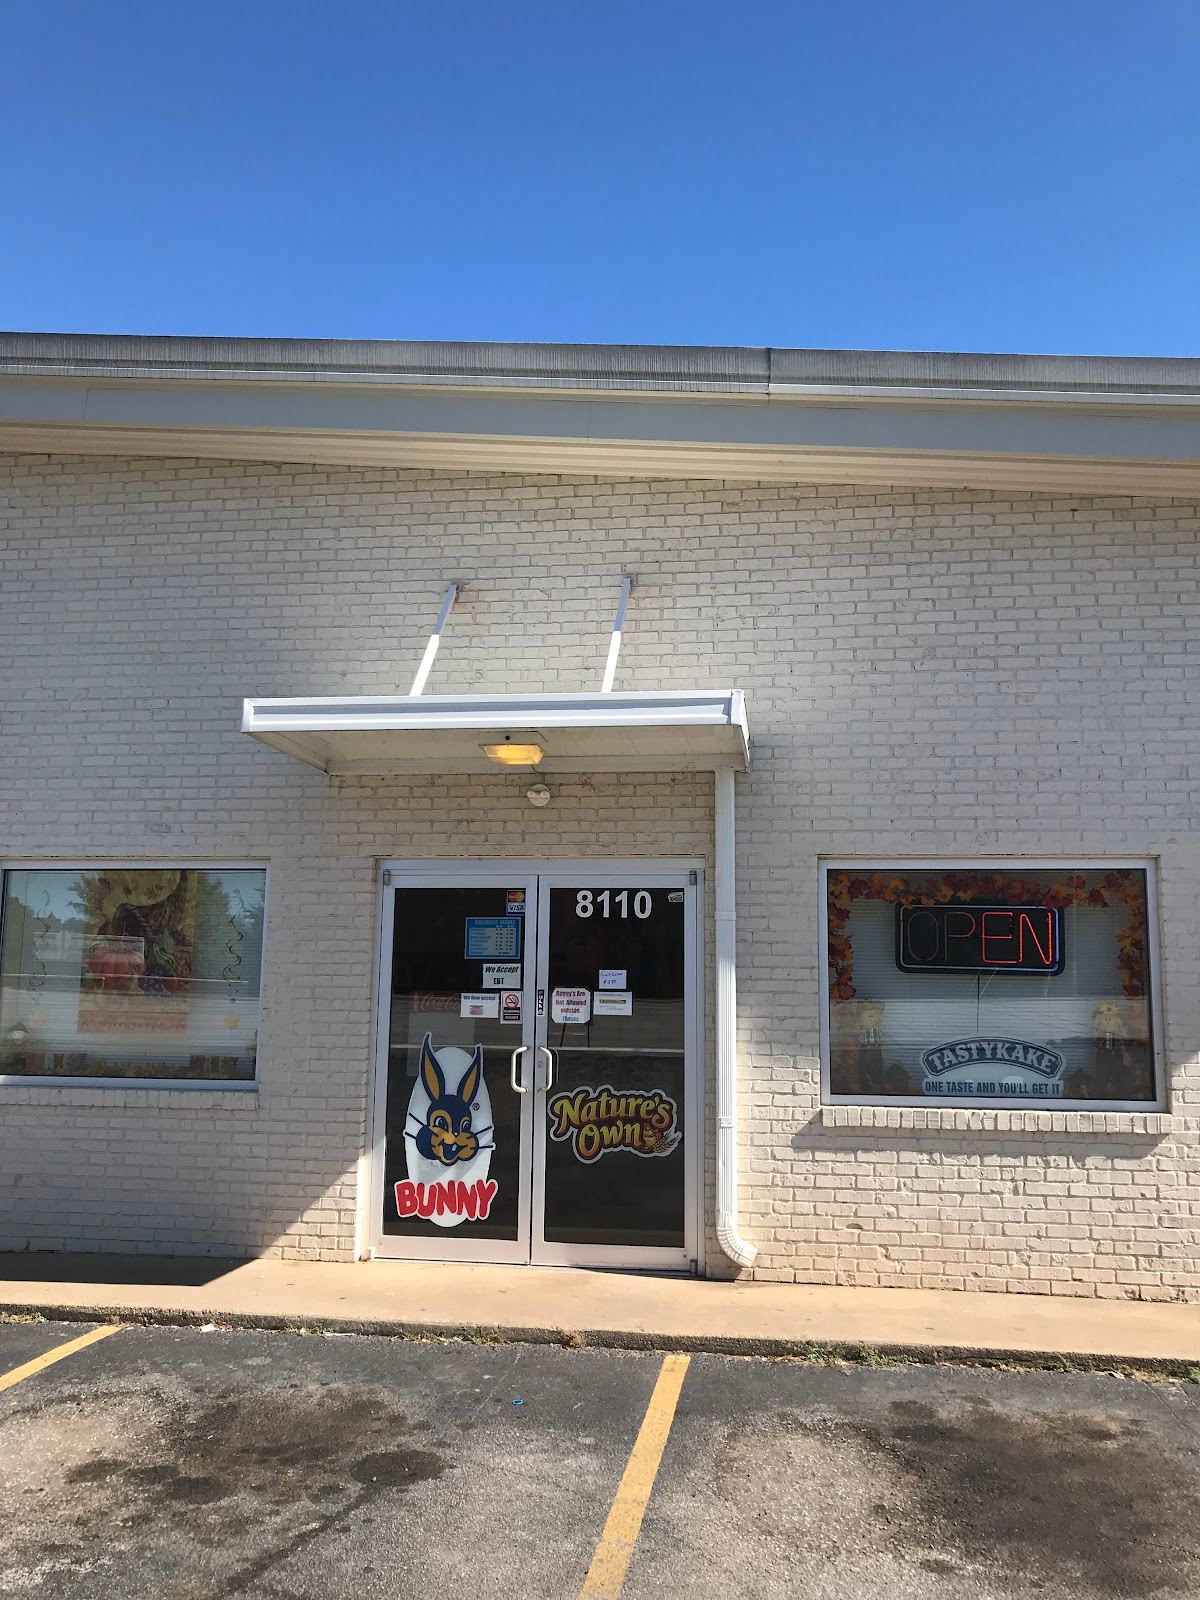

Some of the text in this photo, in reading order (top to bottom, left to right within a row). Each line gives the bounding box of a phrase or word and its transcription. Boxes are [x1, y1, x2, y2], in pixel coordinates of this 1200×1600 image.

[575, 890, 652, 919] 8110
[907, 911, 1053, 965] OPEN
[493, 977, 505, 985] EBT
[496, 966, 519, 974] Accept
[928, 1041, 1057, 1071] TASTYKAKE
[925, 1081, 1061, 1095] ONE TASTE AND YOU'LL GET IT
[553, 1091, 670, 1135] Nature's
[578, 1120, 641, 1158] Own
[395, 1179, 497, 1219] BUNNY
